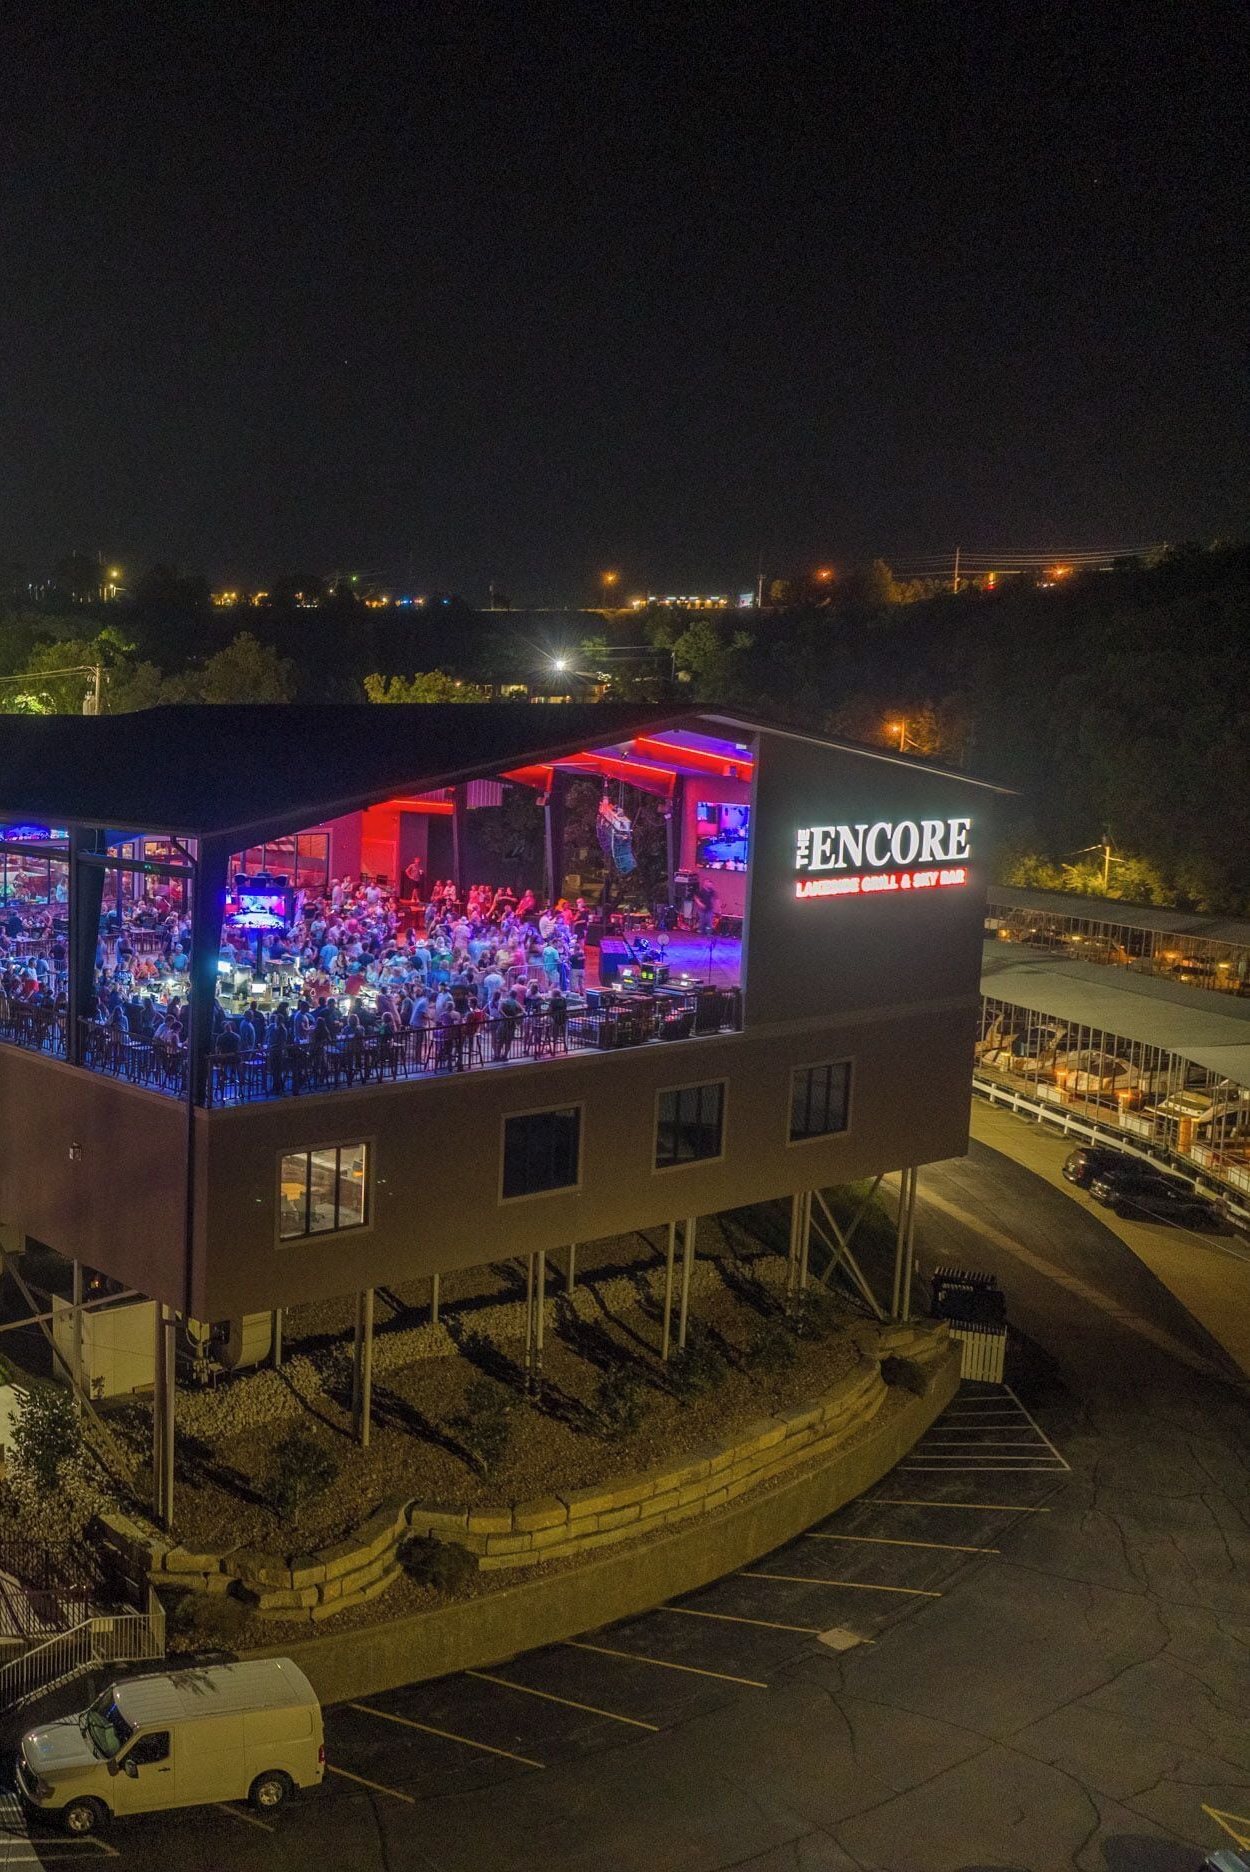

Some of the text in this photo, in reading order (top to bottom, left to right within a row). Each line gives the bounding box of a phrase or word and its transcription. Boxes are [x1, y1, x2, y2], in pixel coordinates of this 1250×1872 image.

[795, 828, 810, 869] THE
[807, 818, 971, 870] ENCORE
[795, 869, 965, 898] LAKESIDE GRILL & SKY BAR
